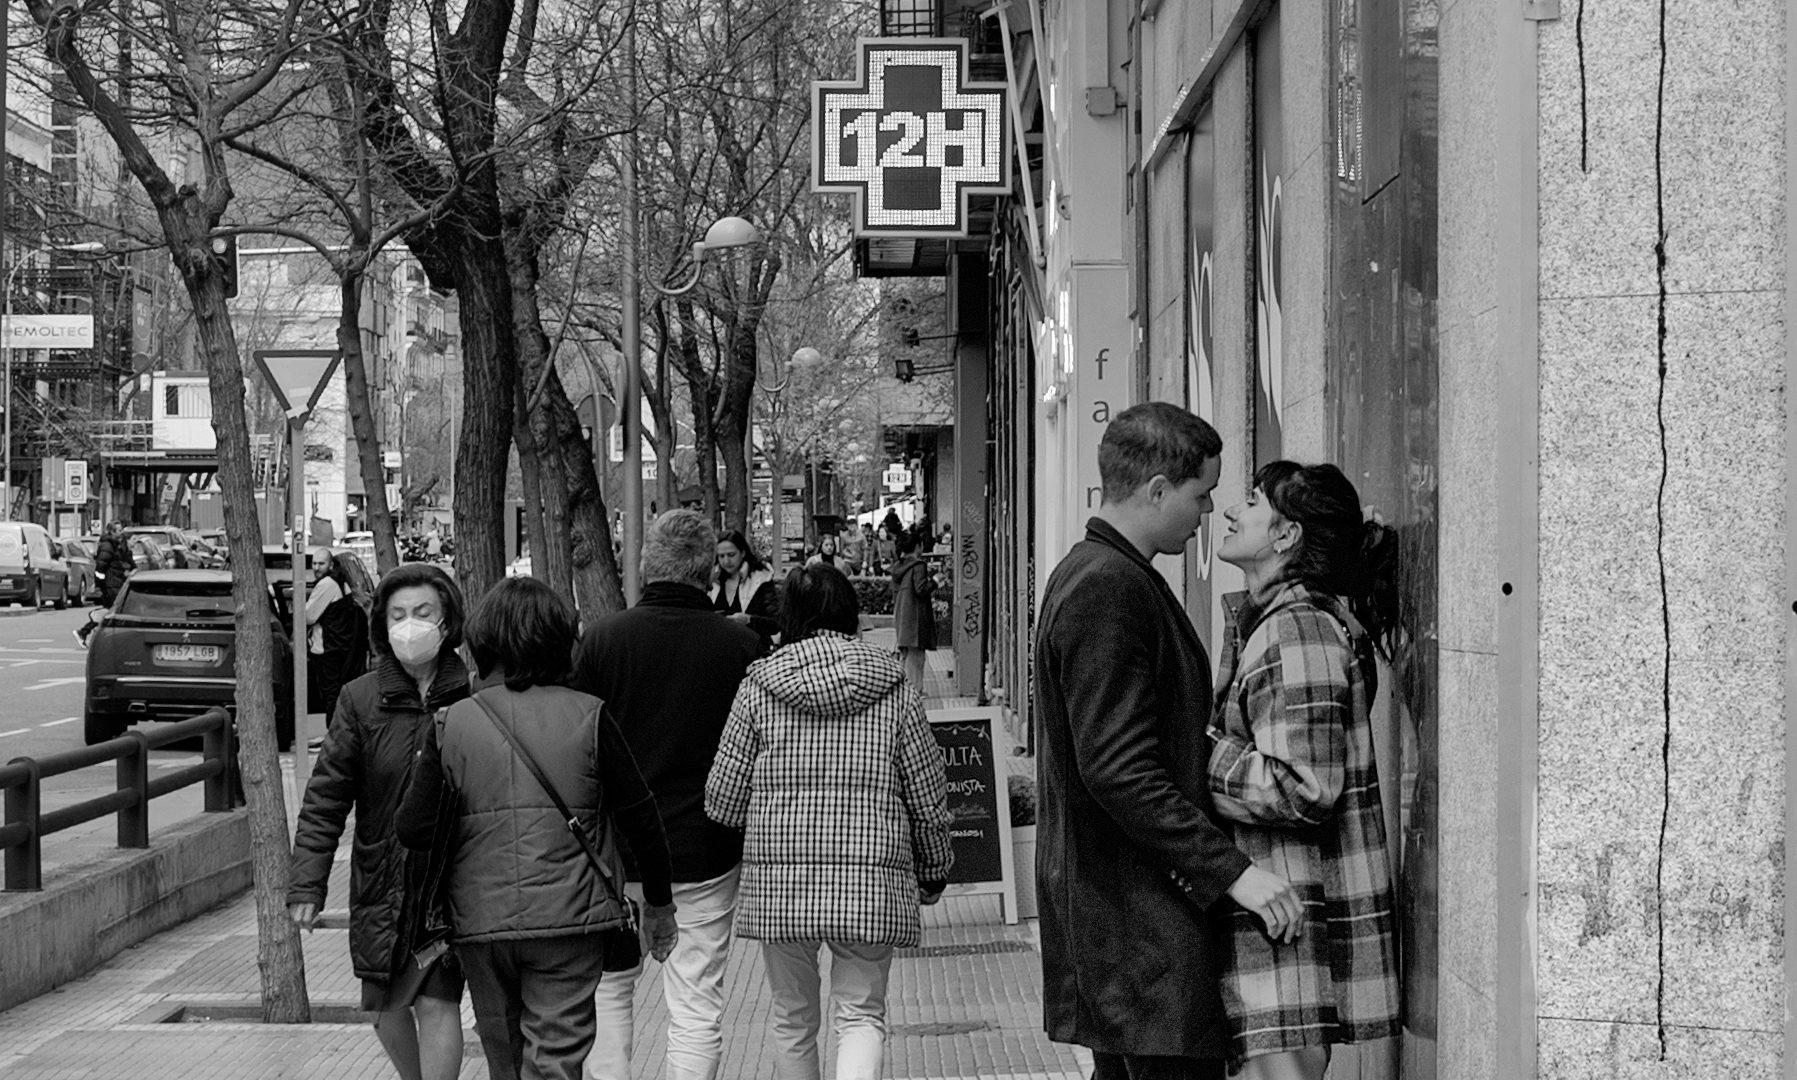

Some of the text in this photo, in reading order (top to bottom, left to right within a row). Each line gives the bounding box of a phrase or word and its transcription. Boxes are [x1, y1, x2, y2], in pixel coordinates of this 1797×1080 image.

[843, 111, 983, 168] 12H
[4, 326, 88, 337] EMOLTEC
[165, 646, 191, 657] 1957
